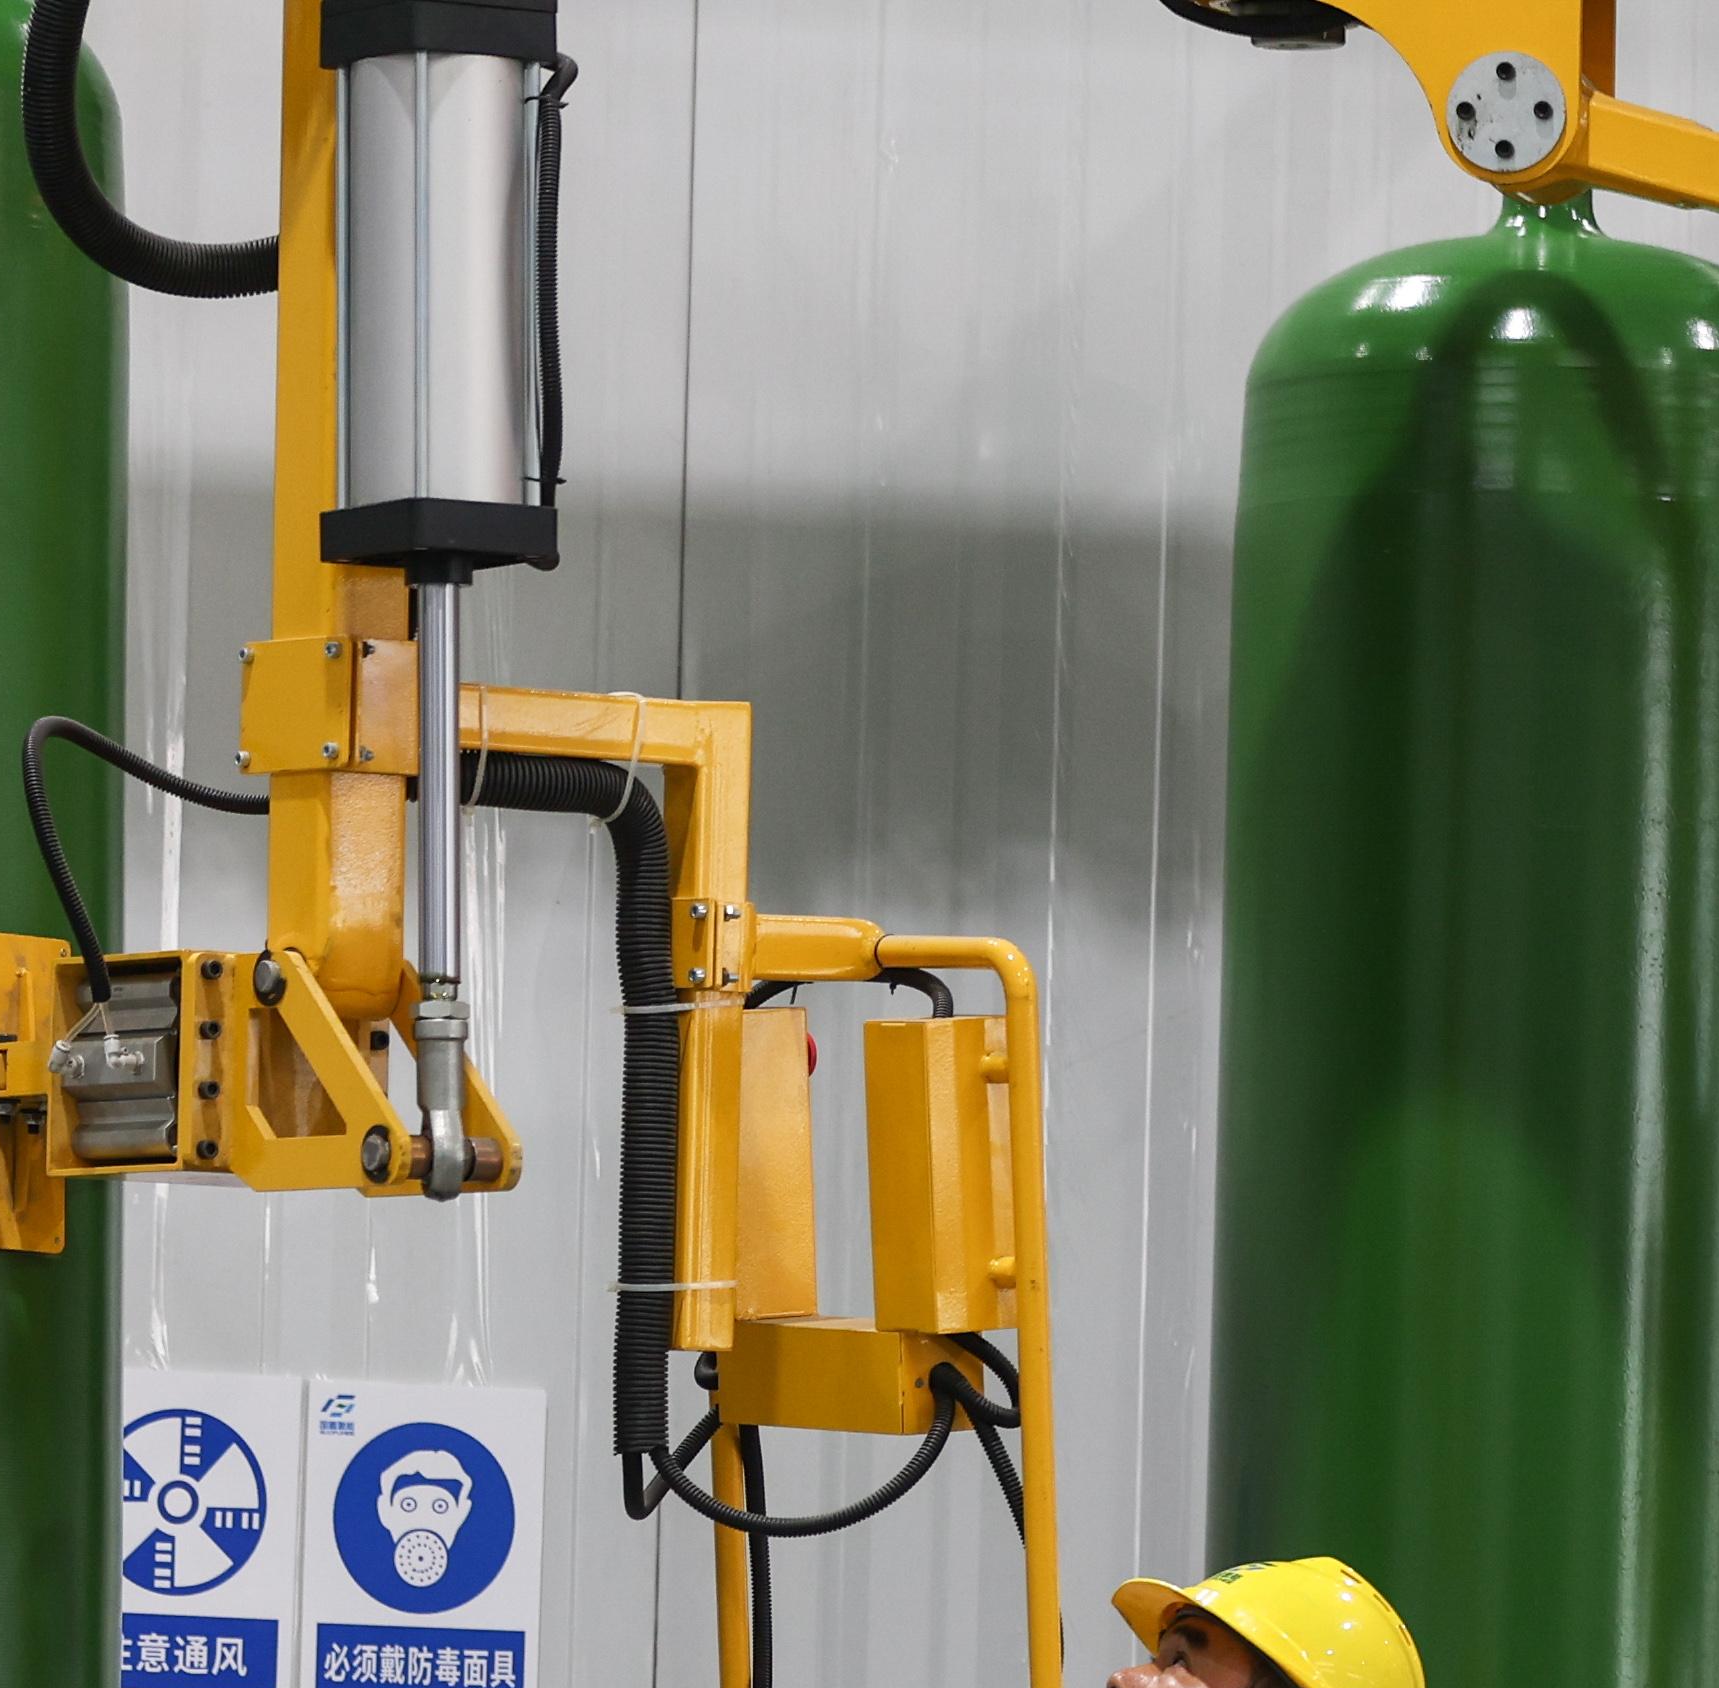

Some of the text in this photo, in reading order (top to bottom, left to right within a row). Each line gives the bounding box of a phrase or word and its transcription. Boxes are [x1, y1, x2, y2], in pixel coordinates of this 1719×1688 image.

[323, 1642, 516, 1688] 必须戴防毒面具
